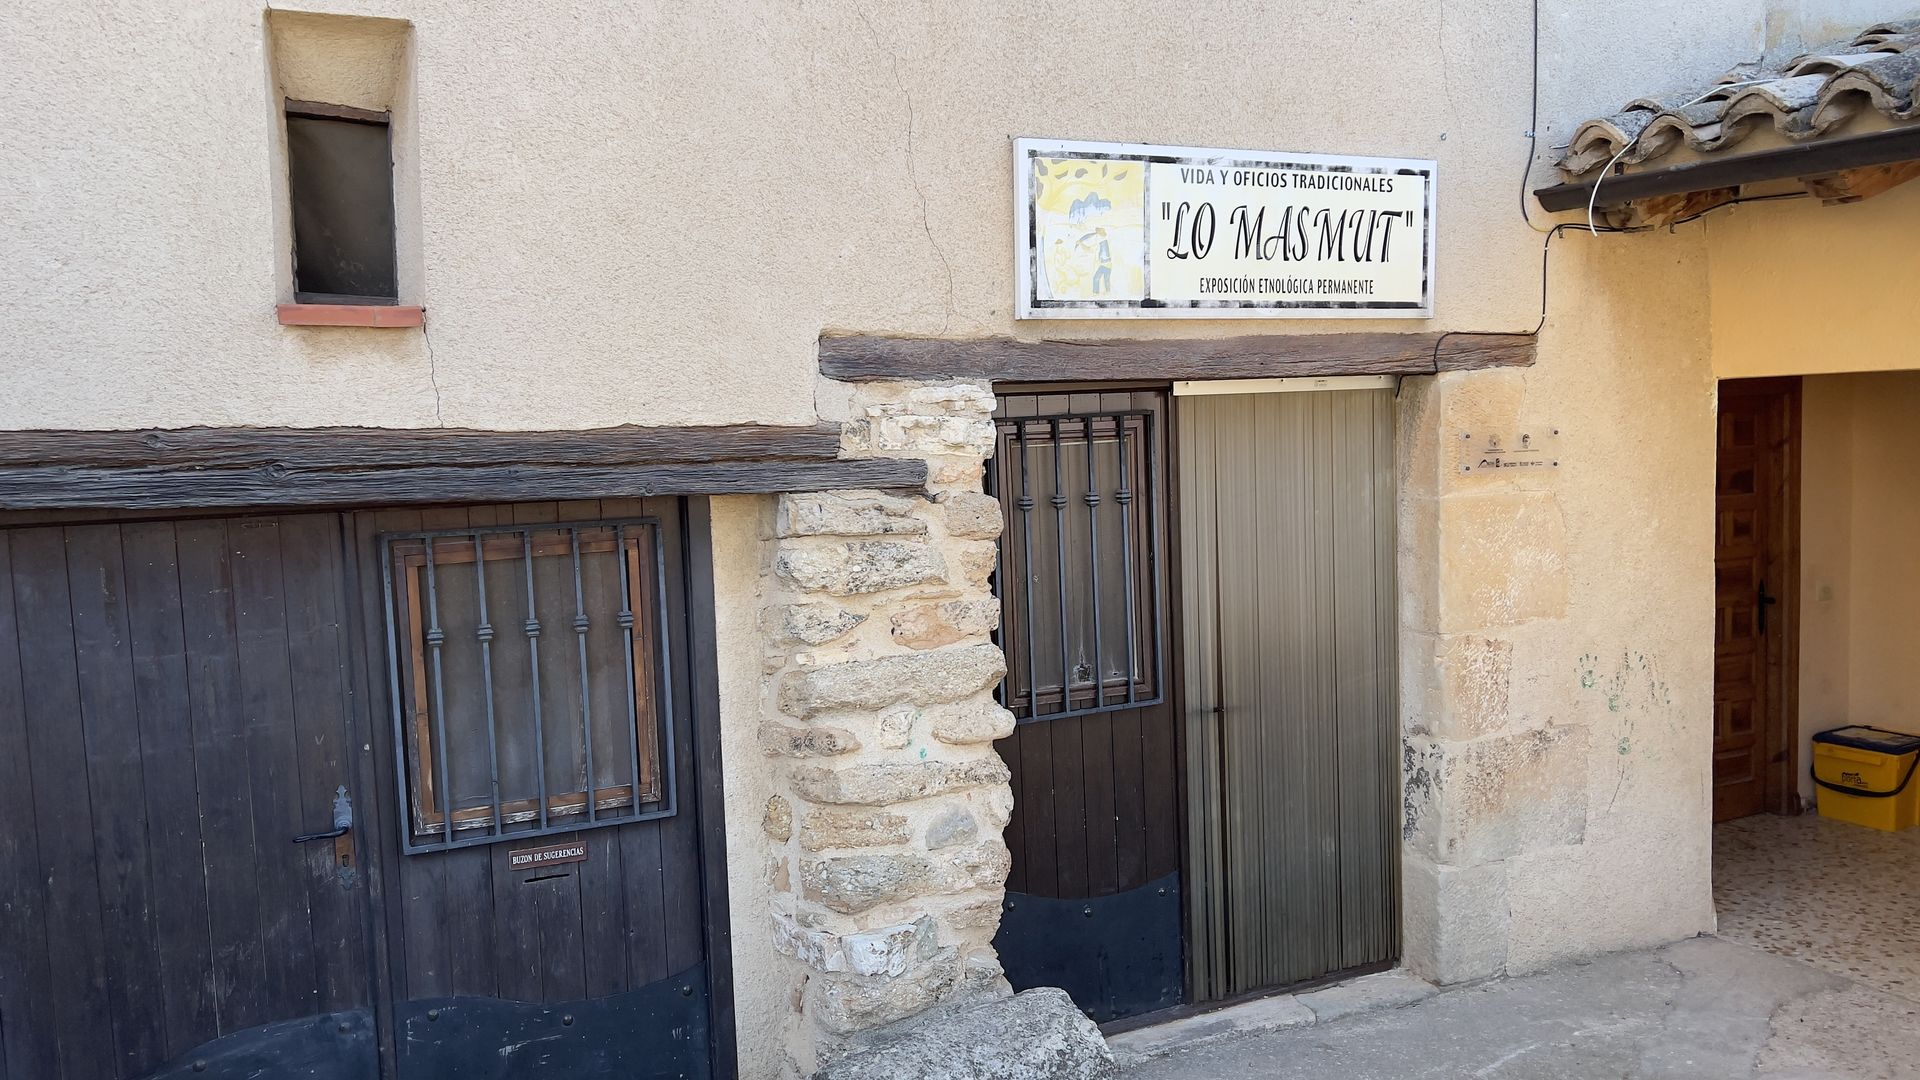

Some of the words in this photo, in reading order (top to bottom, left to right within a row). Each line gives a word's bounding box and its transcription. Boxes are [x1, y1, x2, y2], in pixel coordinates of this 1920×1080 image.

[1180, 167, 1215, 185] VIDA
[1219, 170, 1229, 186] Y
[1233, 171, 1288, 188] OFICIOS
[1292, 173, 1394, 193] TRADICIONALES
[1200, 274, 1255, 294] EXPOSICIÓN
[1258, 276, 1314, 294] ETNOLÓGICA
[1317, 280, 1374, 295] PERMANENTE
[512, 854, 533, 865] BUZON
[534, 853, 543, 862] DE
[543, 846, 584, 860] SUGERENCIAS
